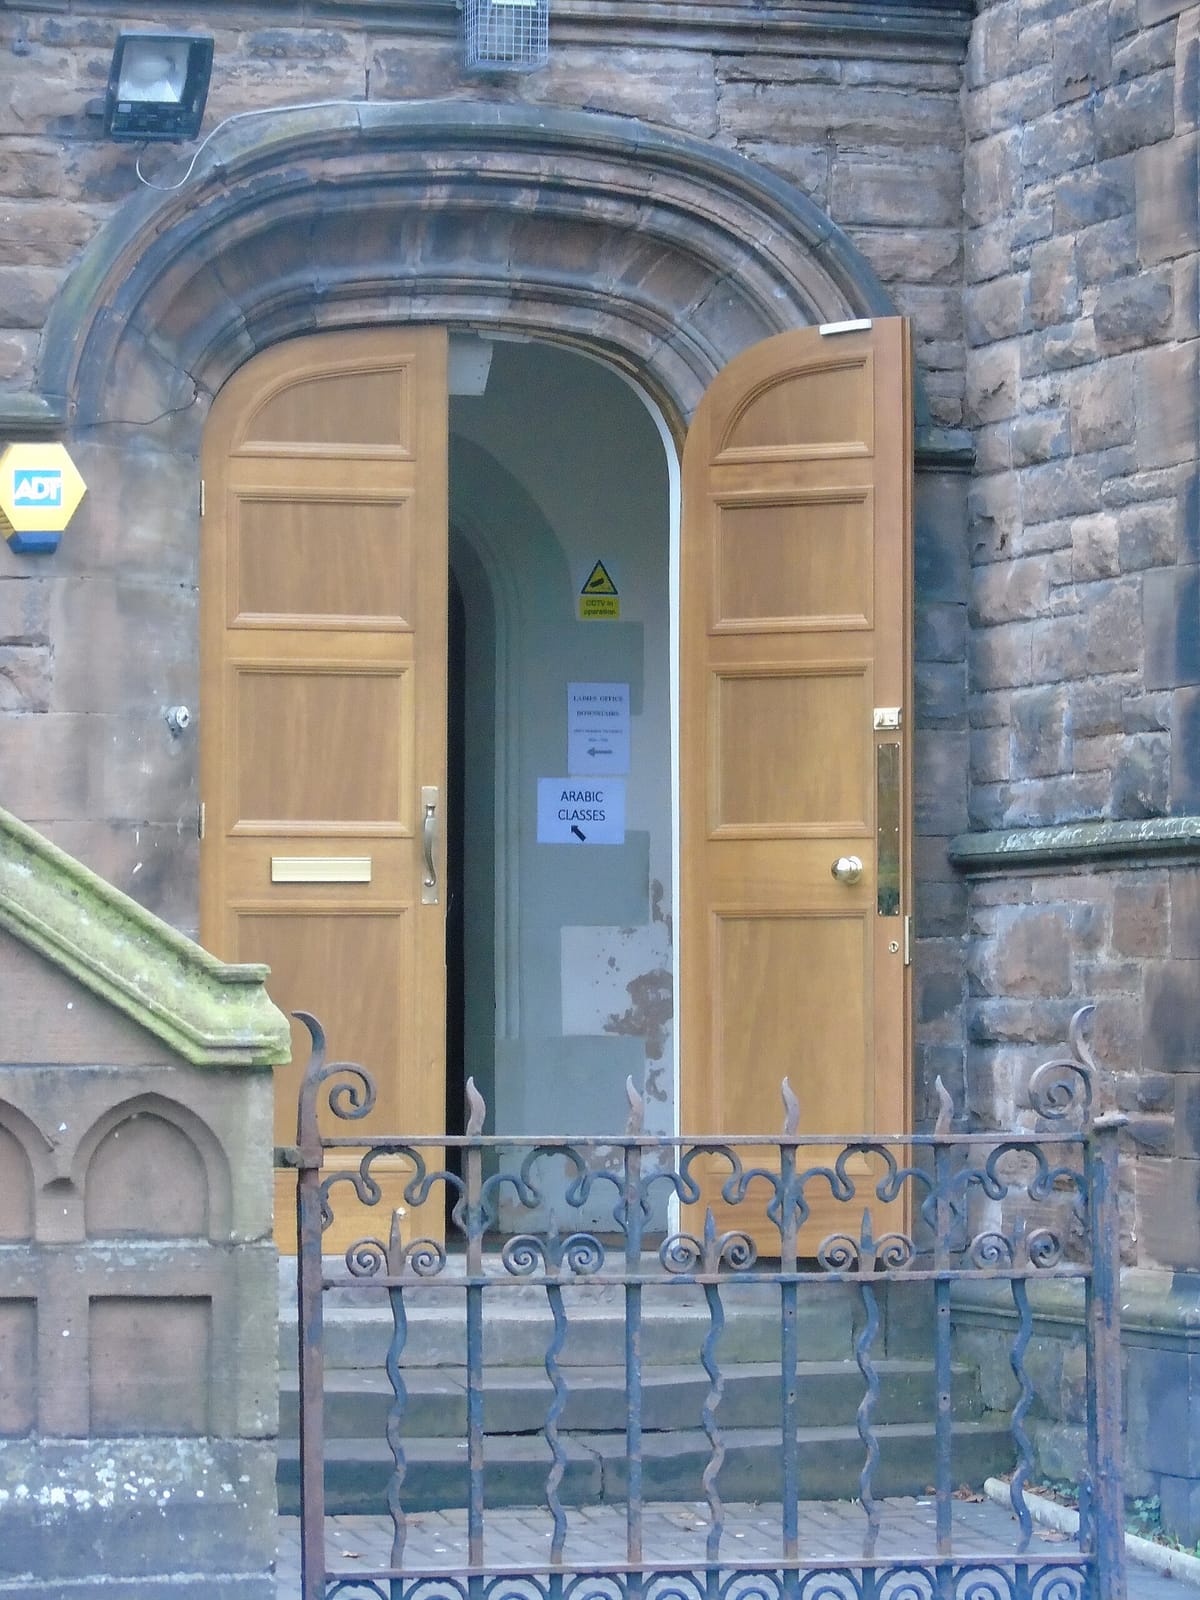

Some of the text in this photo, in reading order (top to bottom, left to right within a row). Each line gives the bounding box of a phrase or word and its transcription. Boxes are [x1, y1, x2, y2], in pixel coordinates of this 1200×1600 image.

[15, 476, 61, 500] ADT
[560, 790, 604, 802] ARABIC
[558, 809, 606, 821] CLASSES
